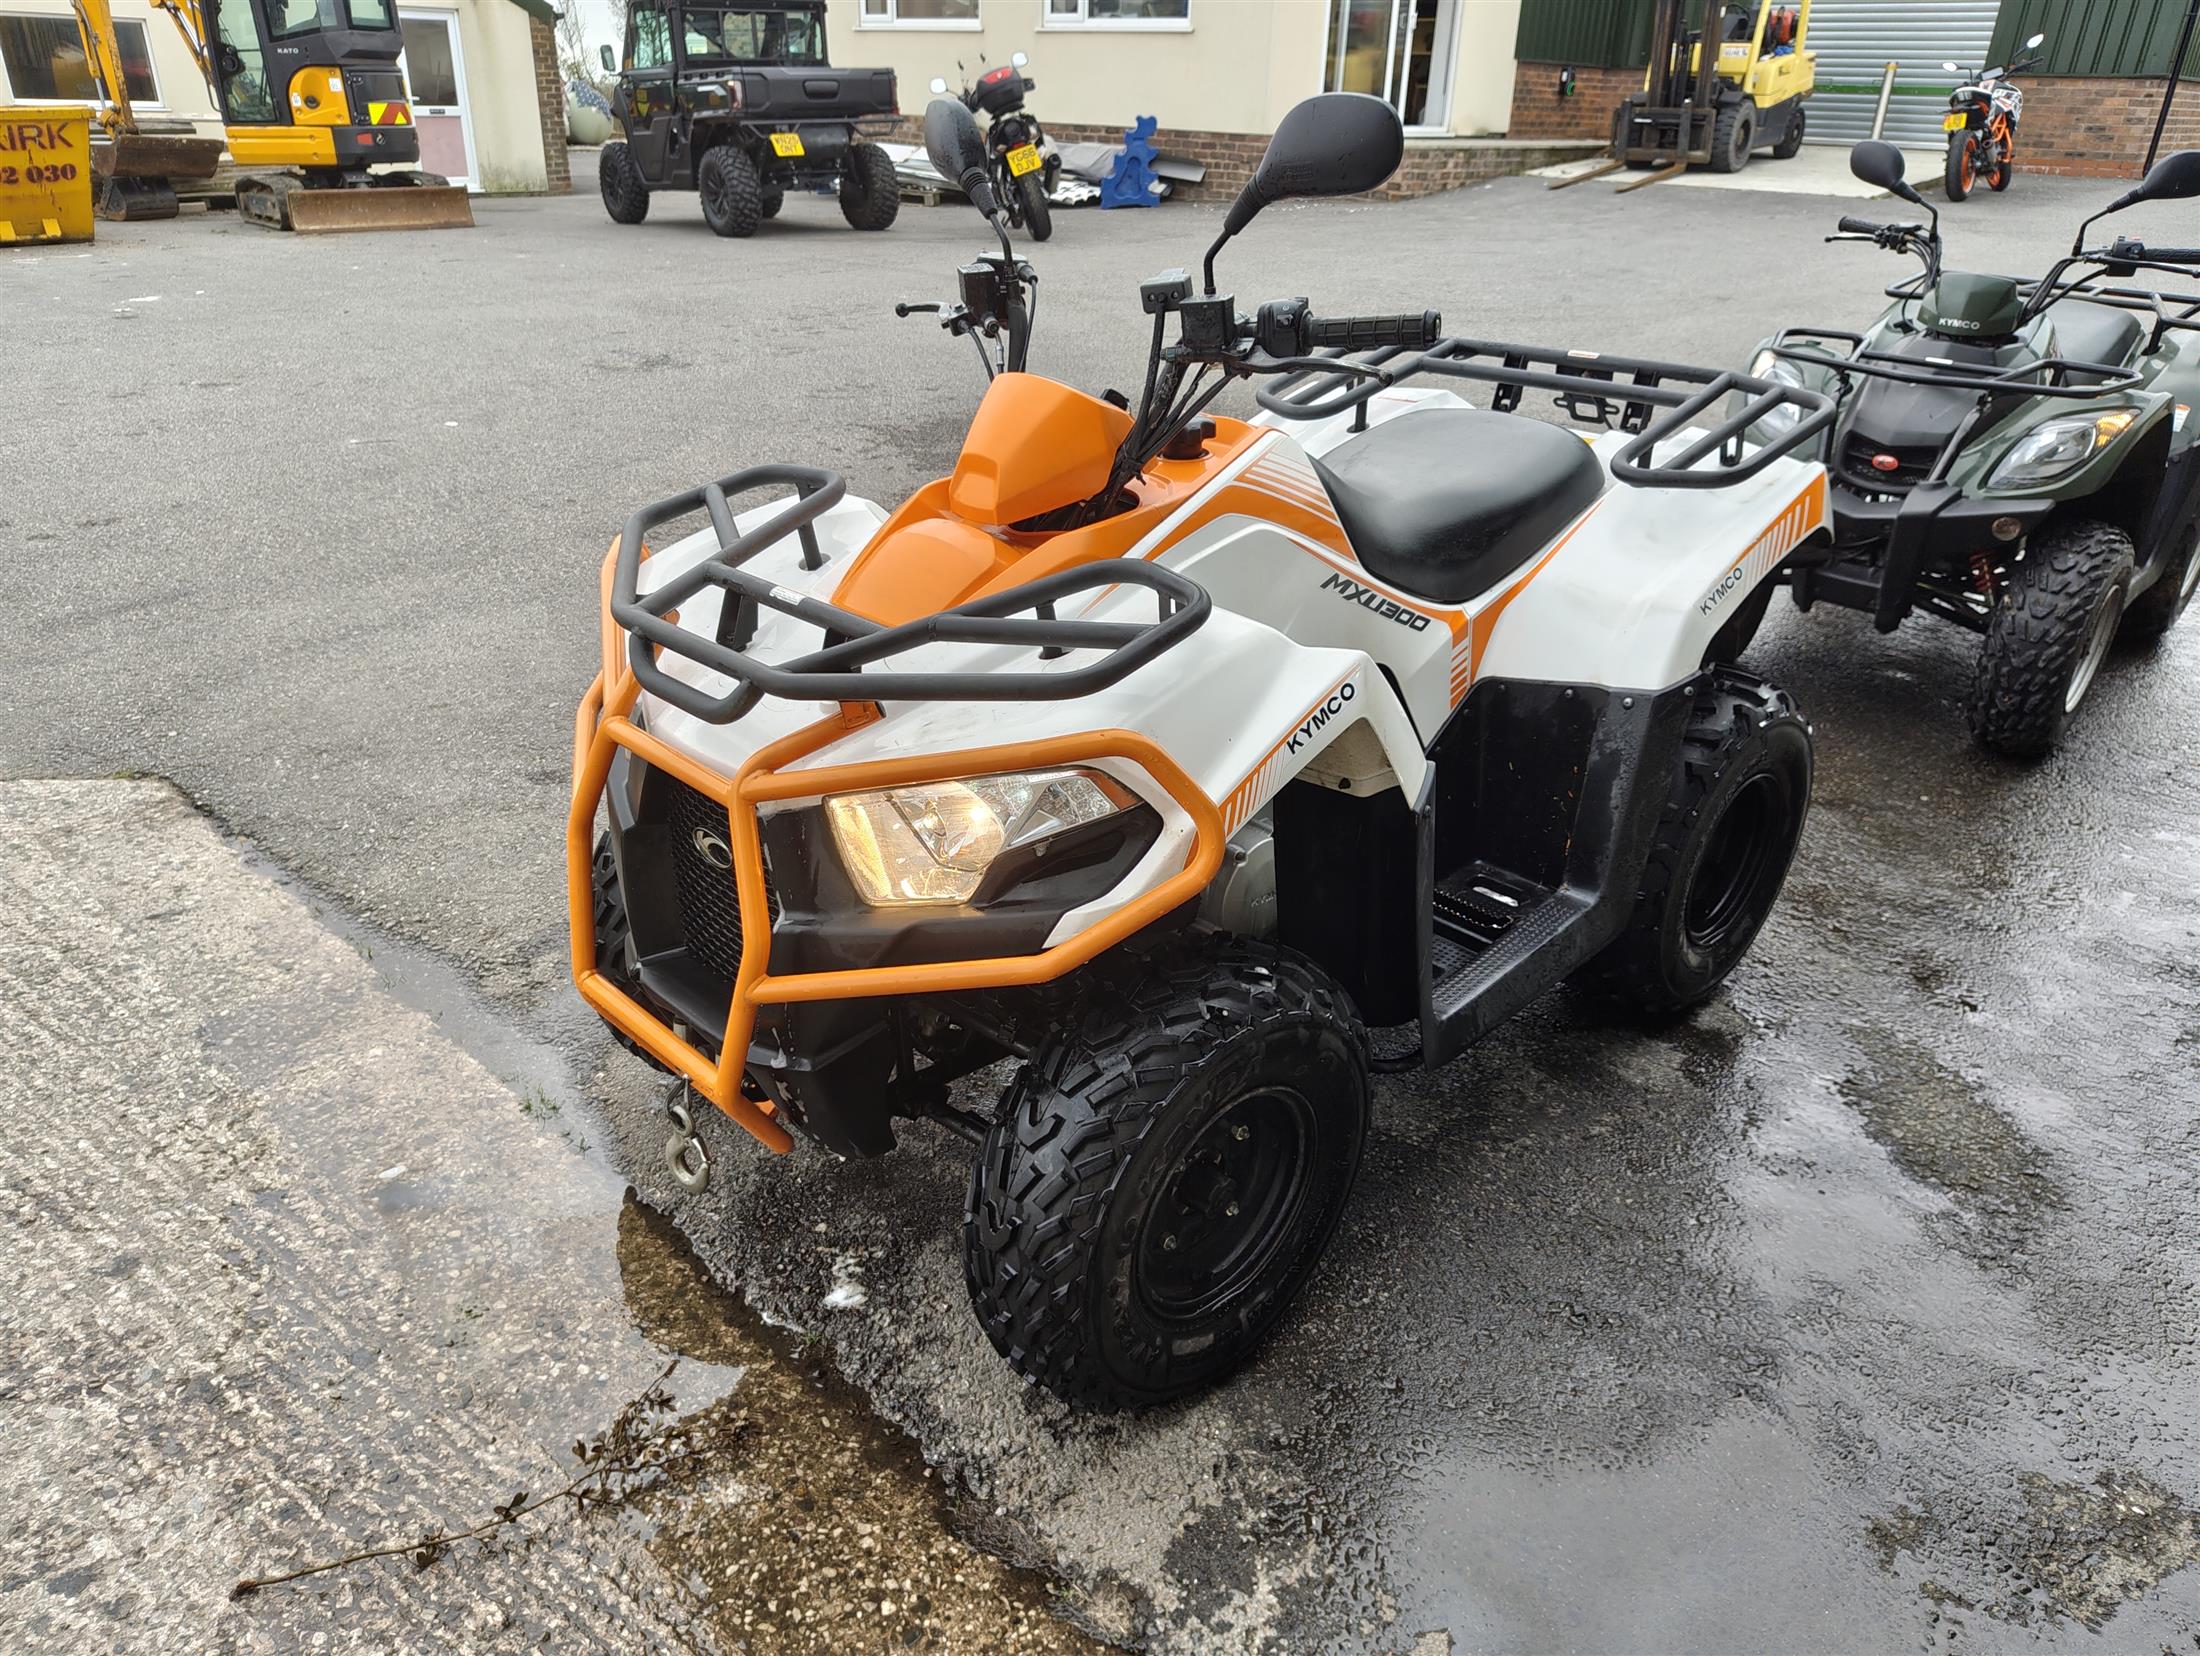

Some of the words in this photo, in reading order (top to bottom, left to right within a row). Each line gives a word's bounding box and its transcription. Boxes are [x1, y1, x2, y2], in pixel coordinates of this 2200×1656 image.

[0, 121, 73, 151] IRK
[26, 163, 77, 184] 030
[1938, 317, 1980, 330] KYMCO
[1319, 572, 1432, 632] MXU300
[1700, 567, 1743, 616] KYMCO
[1286, 682, 1356, 755] KYMCO
